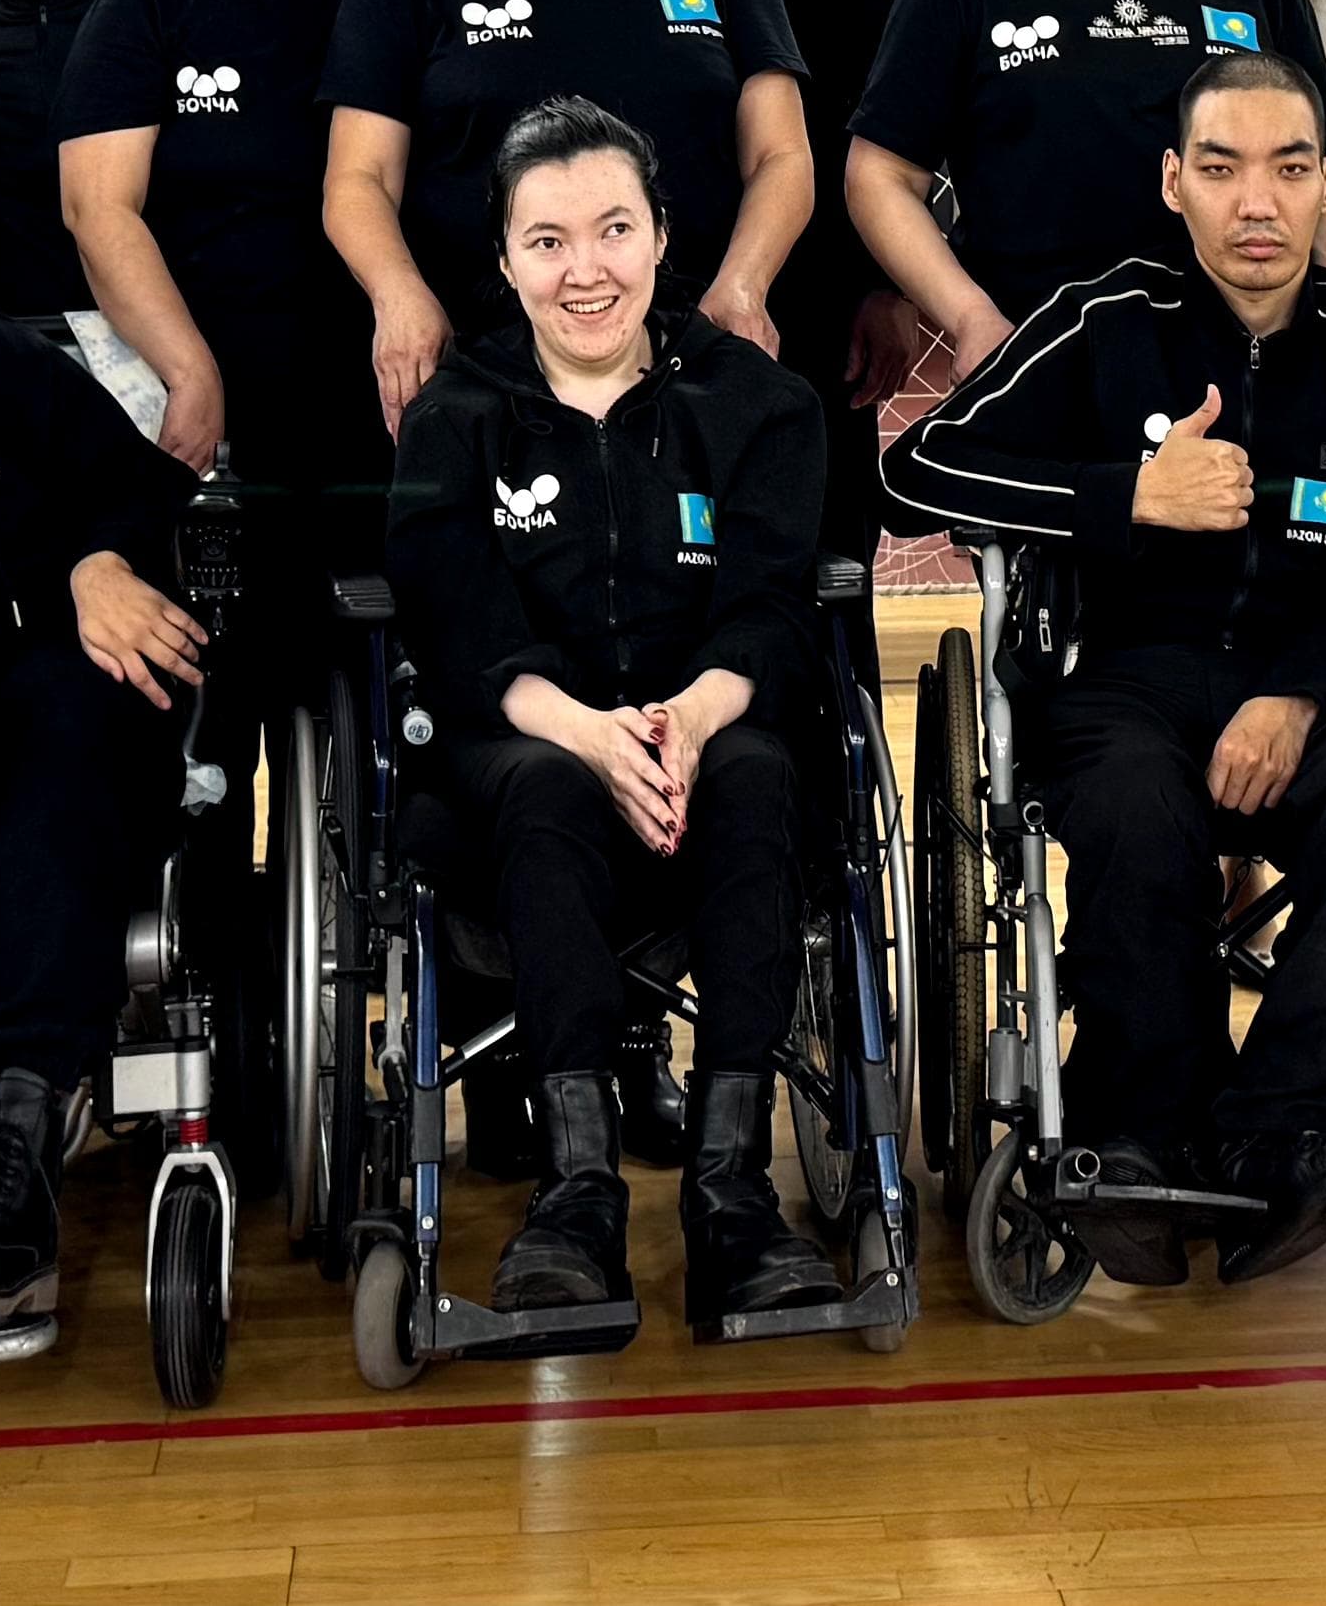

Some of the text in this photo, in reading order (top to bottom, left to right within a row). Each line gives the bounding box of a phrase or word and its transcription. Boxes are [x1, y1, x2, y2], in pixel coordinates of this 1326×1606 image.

[466, 26, 533, 45] БОЧЧА
[999, 44, 1060, 71] БОЧЧА
[177, 97, 239, 113] БОЧЧА
[494, 508, 557, 533] БОЧЧА
